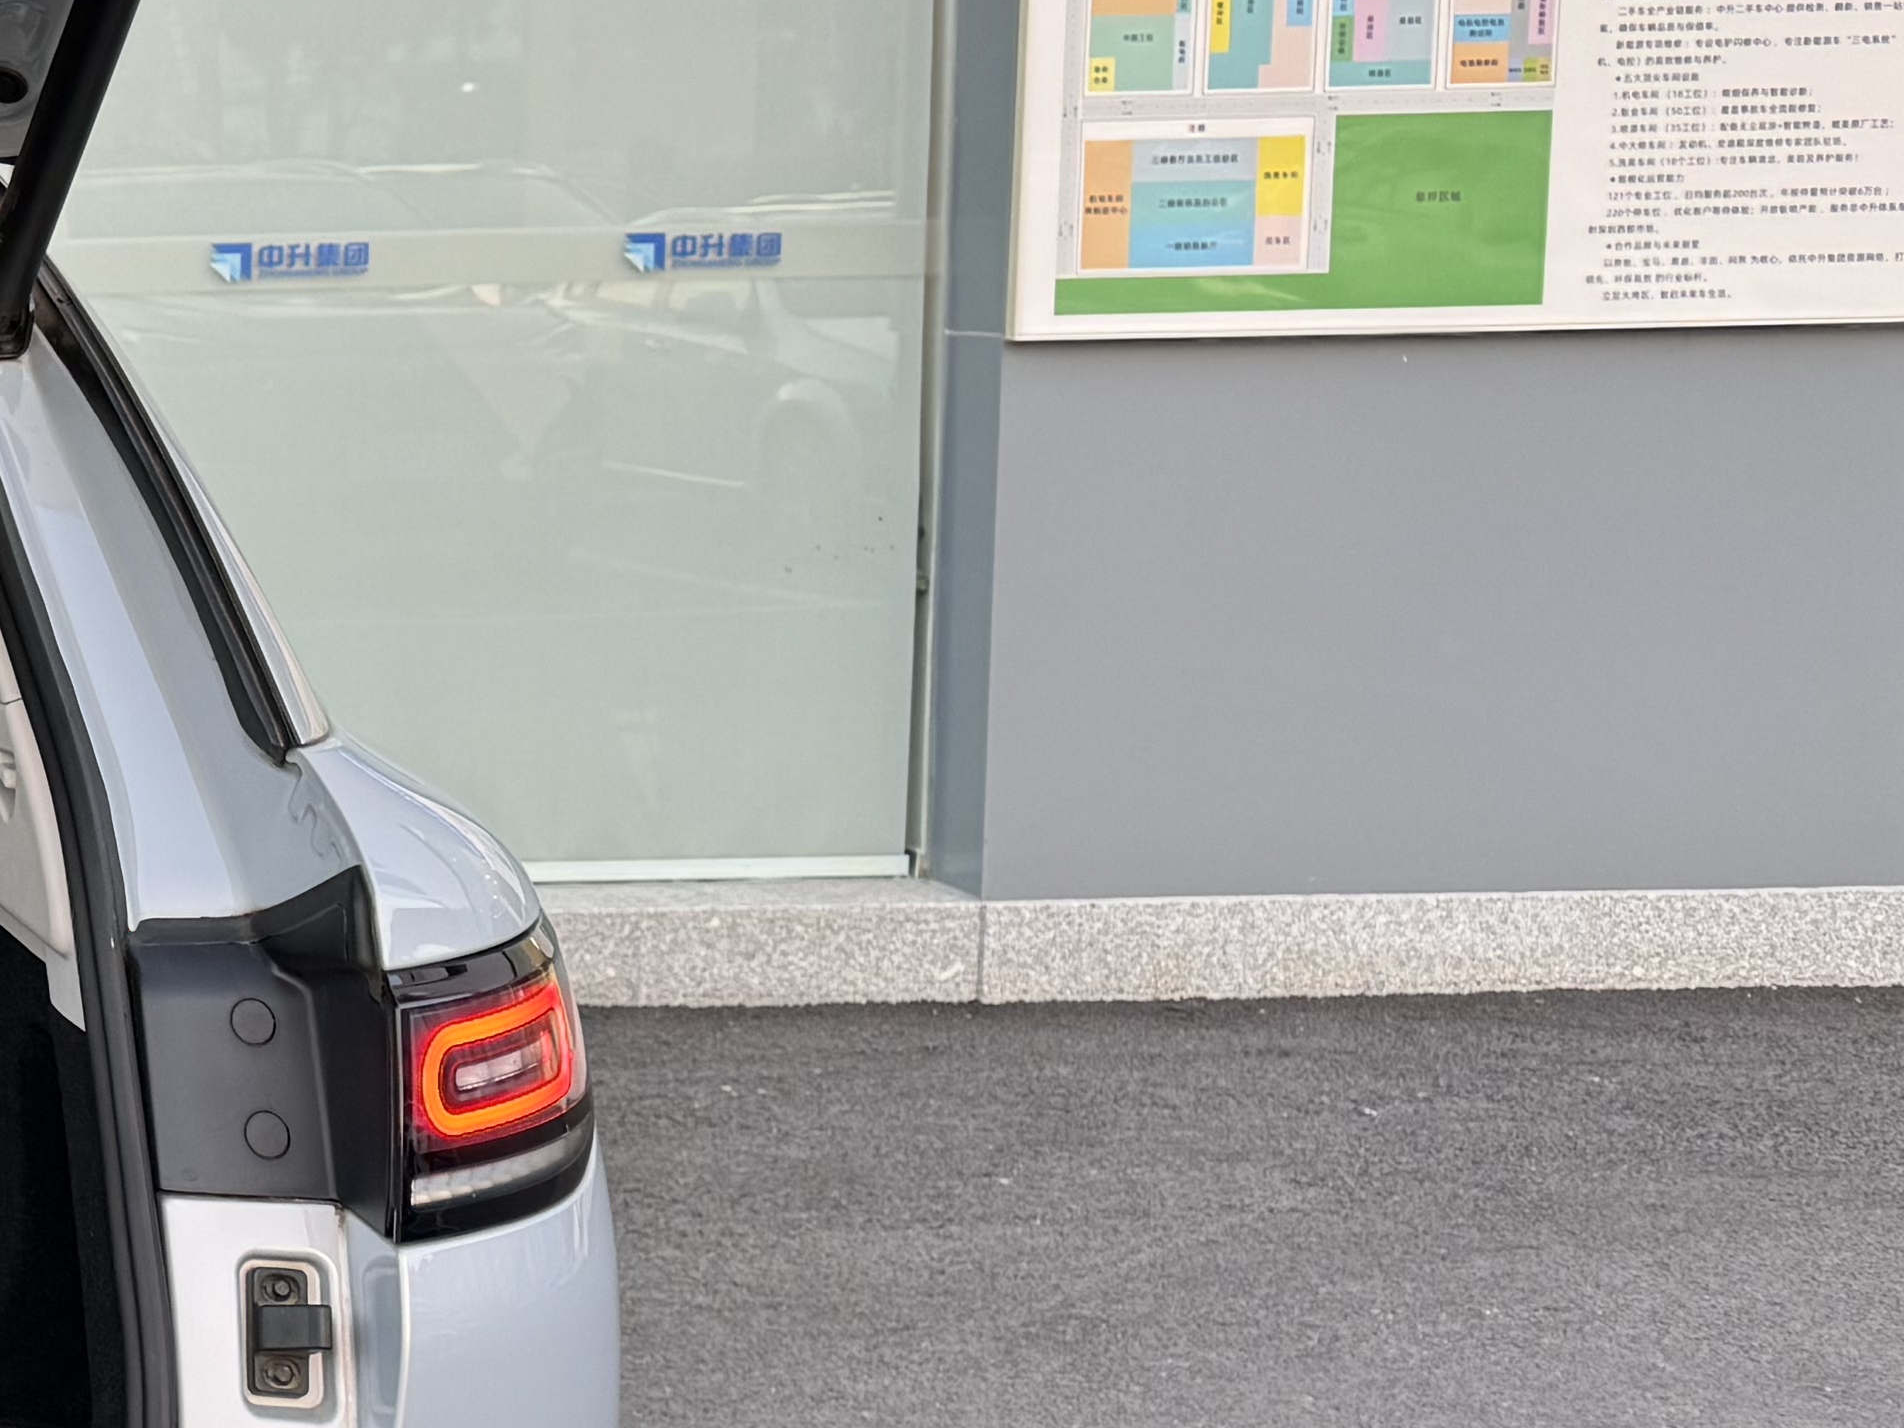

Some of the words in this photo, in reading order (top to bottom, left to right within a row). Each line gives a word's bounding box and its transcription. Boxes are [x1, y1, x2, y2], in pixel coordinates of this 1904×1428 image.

[258, 243, 369, 268] 中升集团
[672, 232, 780, 257] 中升集团
